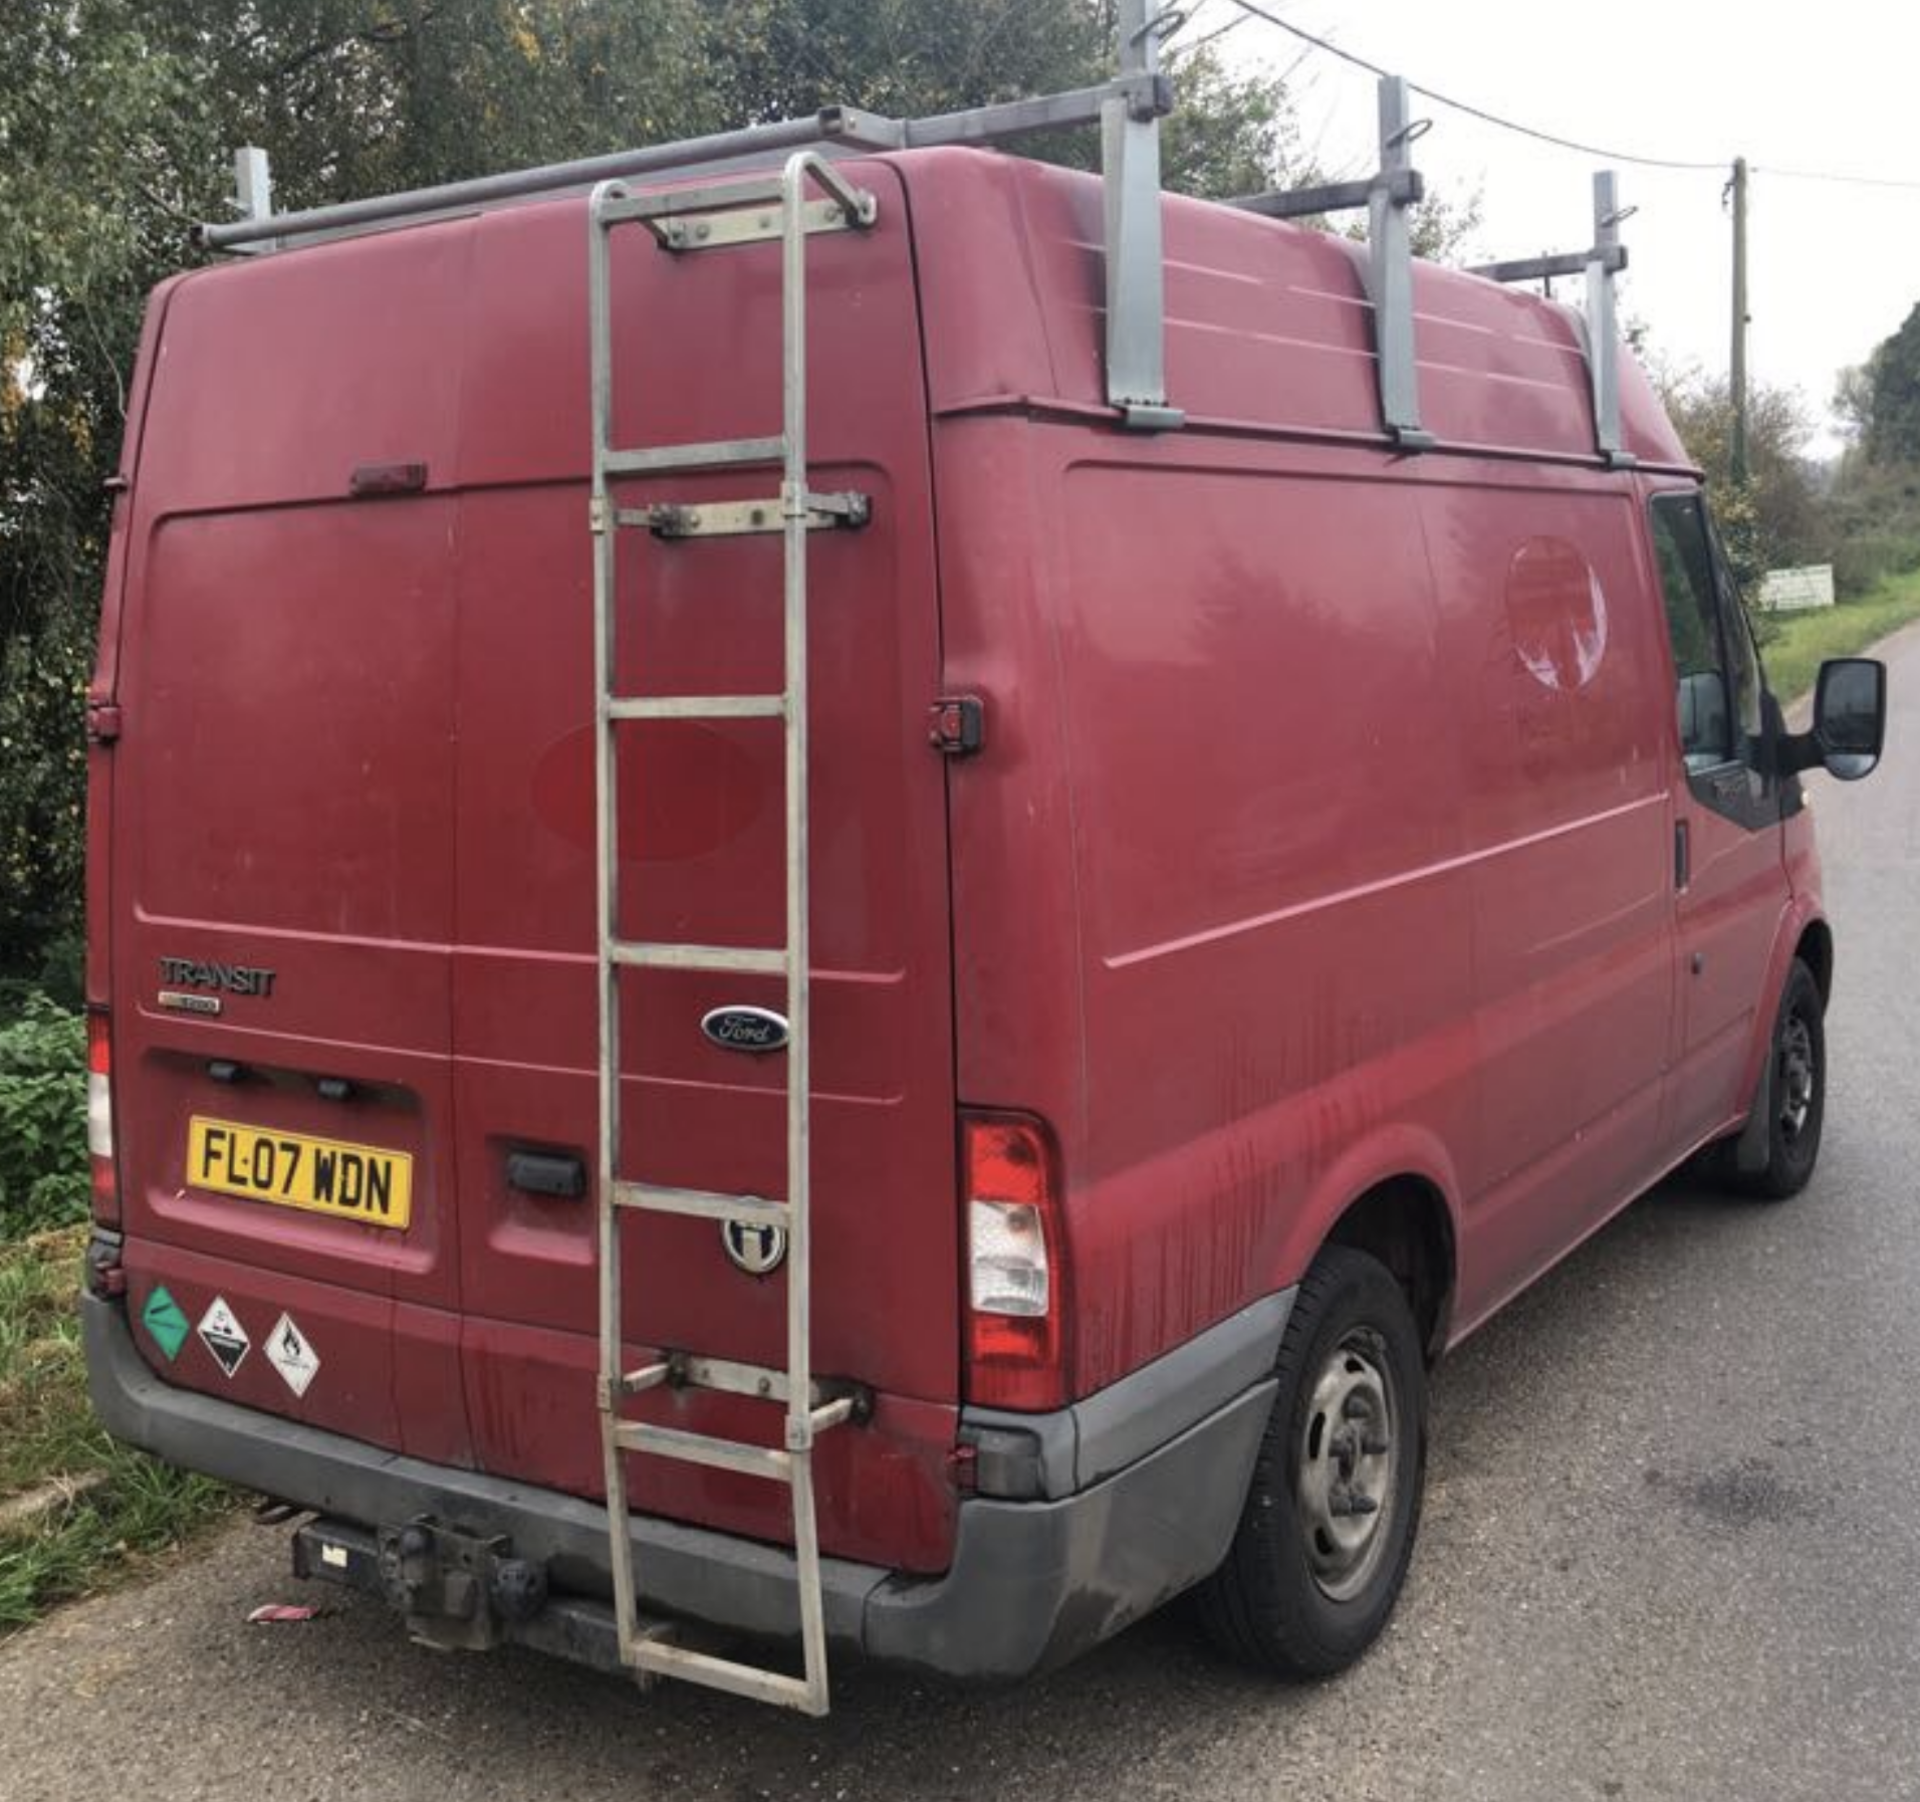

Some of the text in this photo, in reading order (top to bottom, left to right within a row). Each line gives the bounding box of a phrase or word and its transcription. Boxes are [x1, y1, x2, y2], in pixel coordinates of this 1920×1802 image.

[159, 957, 276, 996] TRANSIT
[719, 1015, 771, 1042] Ford
[202, 1128, 392, 1215] FL07 WDN
